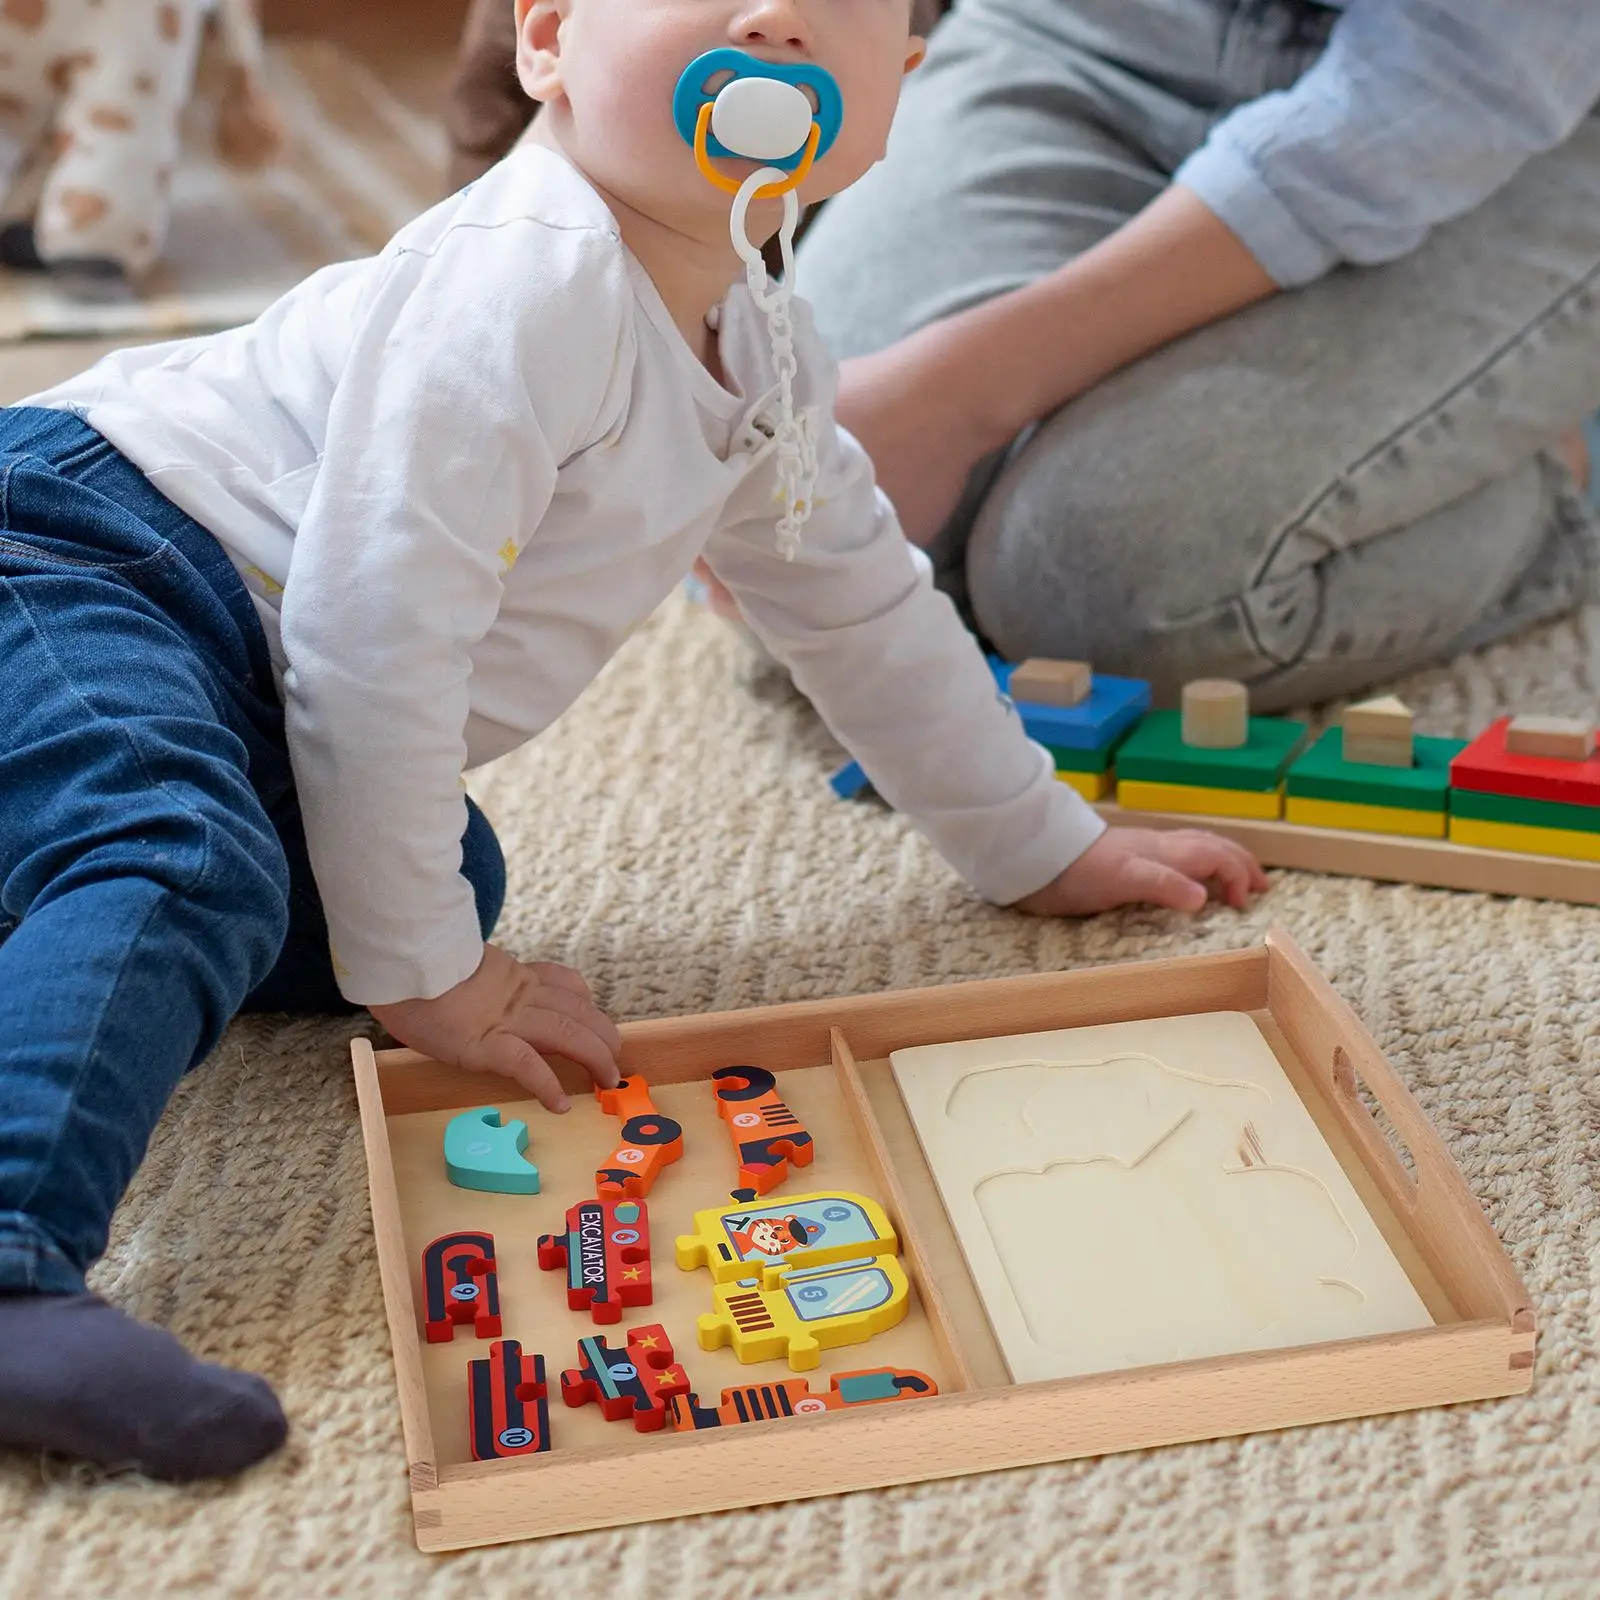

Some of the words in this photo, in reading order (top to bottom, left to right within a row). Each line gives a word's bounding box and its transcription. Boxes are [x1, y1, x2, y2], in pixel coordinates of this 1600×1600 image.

[738, 1115, 754, 1125] 3
[621, 1151, 638, 1161] 2
[615, 1233, 636, 1241] 6
[580, 1211, 605, 1284] EXCAVATOR
[454, 1287, 475, 1295] 9
[803, 1290, 823, 1298] 5
[613, 1366, 633, 1375] 7
[800, 1404, 820, 1413] 8
[506, 1430, 526, 1445] 10
